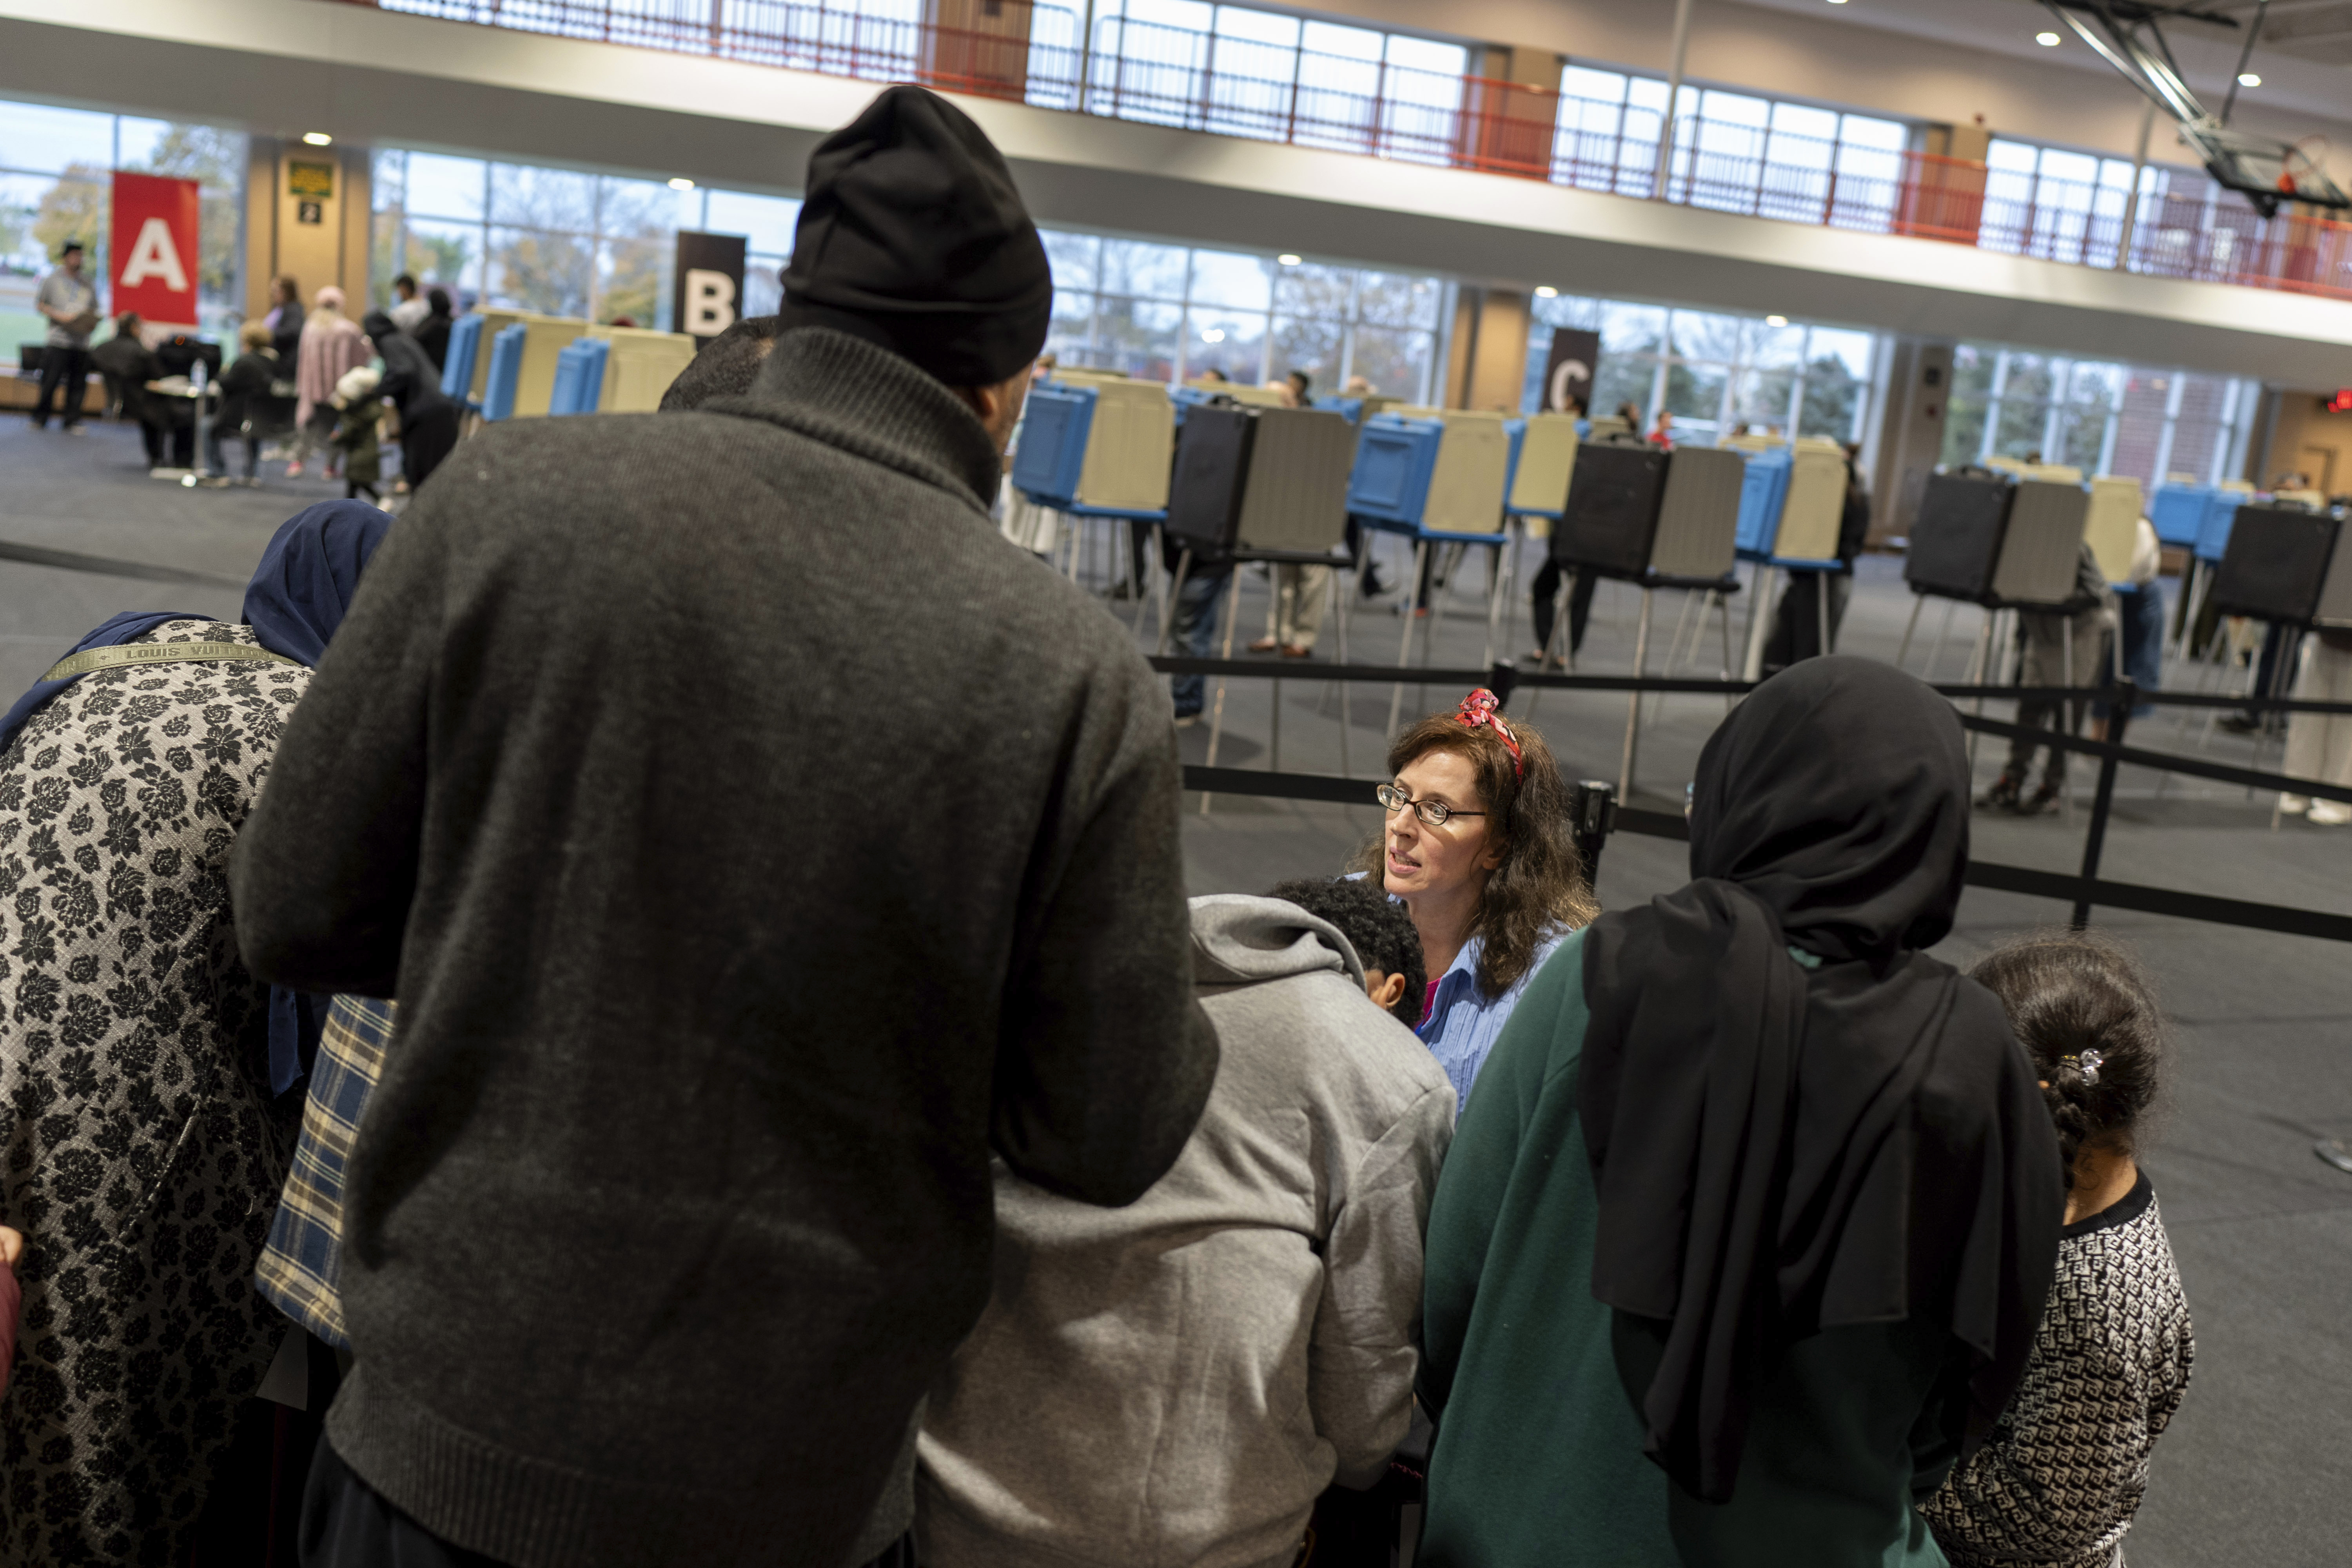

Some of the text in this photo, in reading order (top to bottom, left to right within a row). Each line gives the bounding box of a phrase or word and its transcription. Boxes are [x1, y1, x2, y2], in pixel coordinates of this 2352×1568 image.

[119, 217, 189, 293] A
[683, 268, 736, 337] B
[1550, 358, 1590, 414] C
[127, 647, 180, 659] LOUIS
